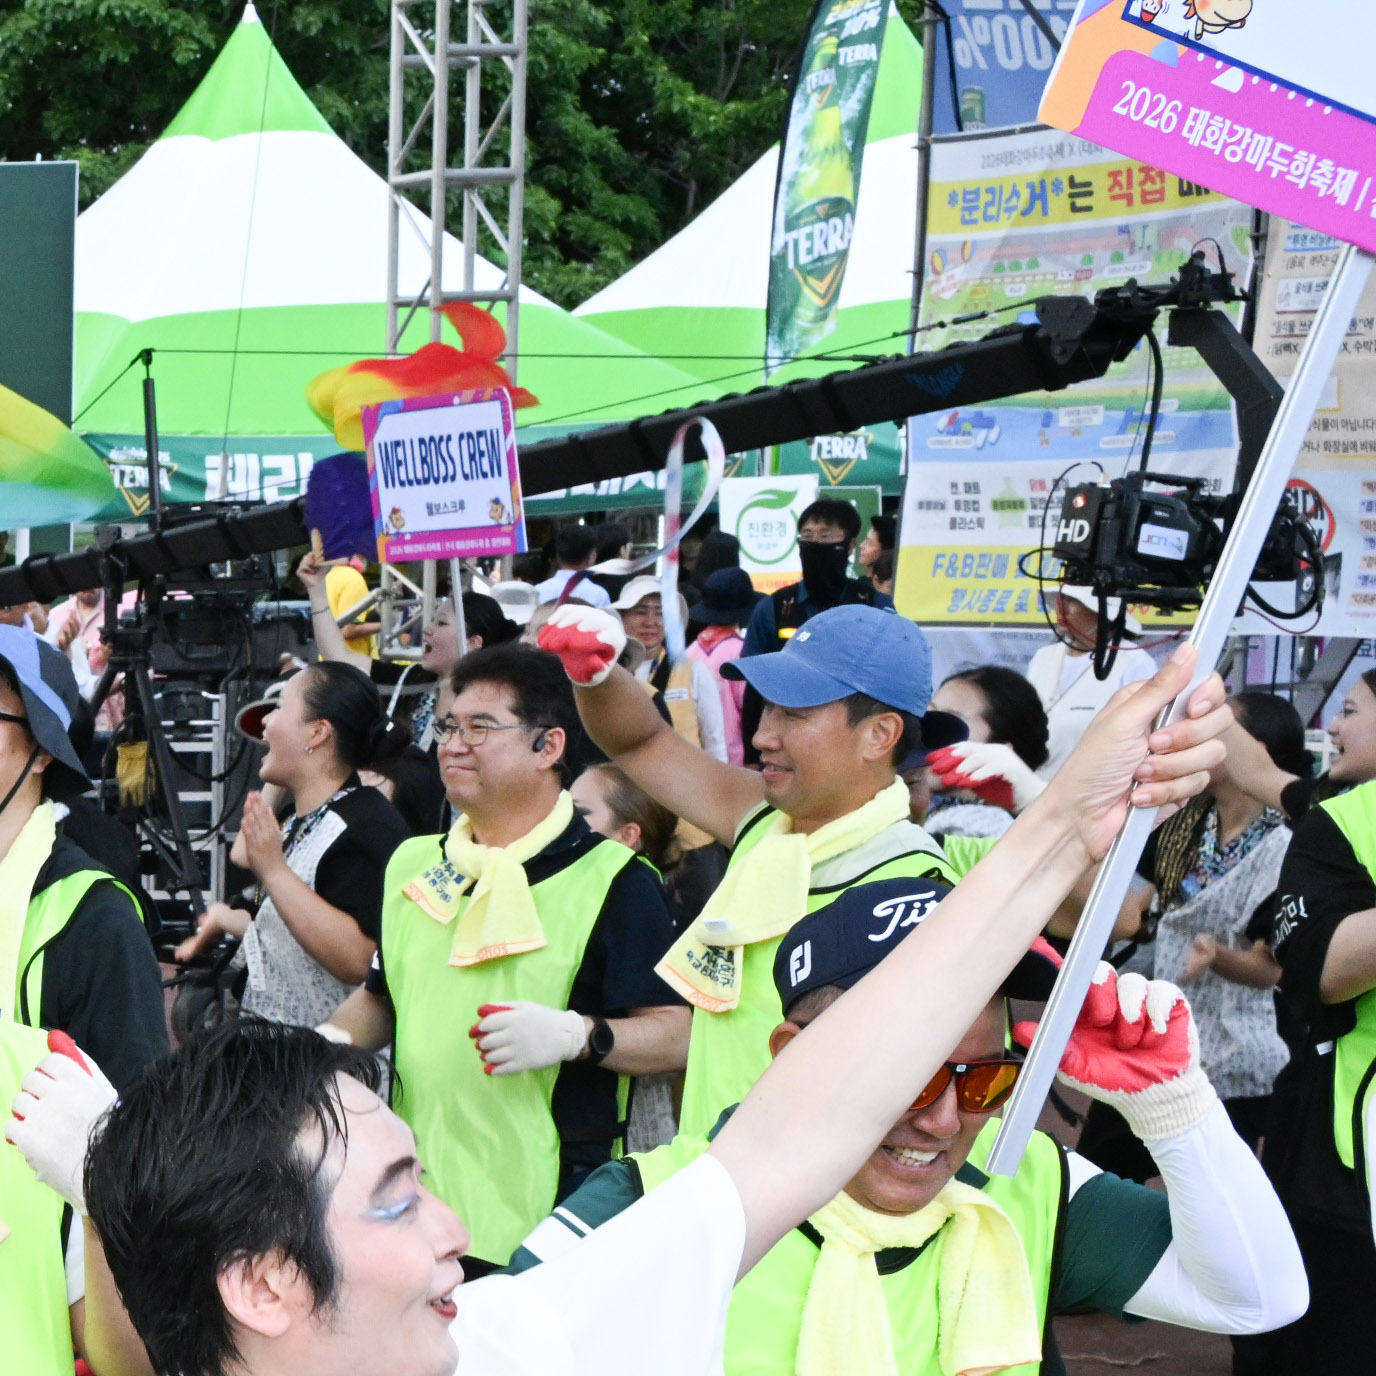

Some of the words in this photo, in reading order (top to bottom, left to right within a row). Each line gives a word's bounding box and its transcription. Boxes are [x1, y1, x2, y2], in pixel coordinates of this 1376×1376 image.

[838, 43, 878, 66] TERRA
[1113, 78, 1181, 136] 2026
[1183, 109, 1356, 208] 태화강마두희축제
[1108, 165, 1166, 207] 직접
[784, 212, 854, 270] TERRA
[1308, 417, 1339, 432] 식물이
[378, 434, 457, 489] WELLBOSS
[458, 427, 502, 481] CREW
[811, 435, 868, 461] TERRA
[110, 464, 172, 492] TERA
[426, 499, 466, 517] 웰보스크루
[748, 520, 787, 539] 친환경
[1057, 519, 1090, 543] HD
[932, 553, 1009, 580] F&B판매
[948, 588, 1009, 614] 행사종료
[868, 890, 941, 941] Tit
[790, 940, 812, 987] FJ
